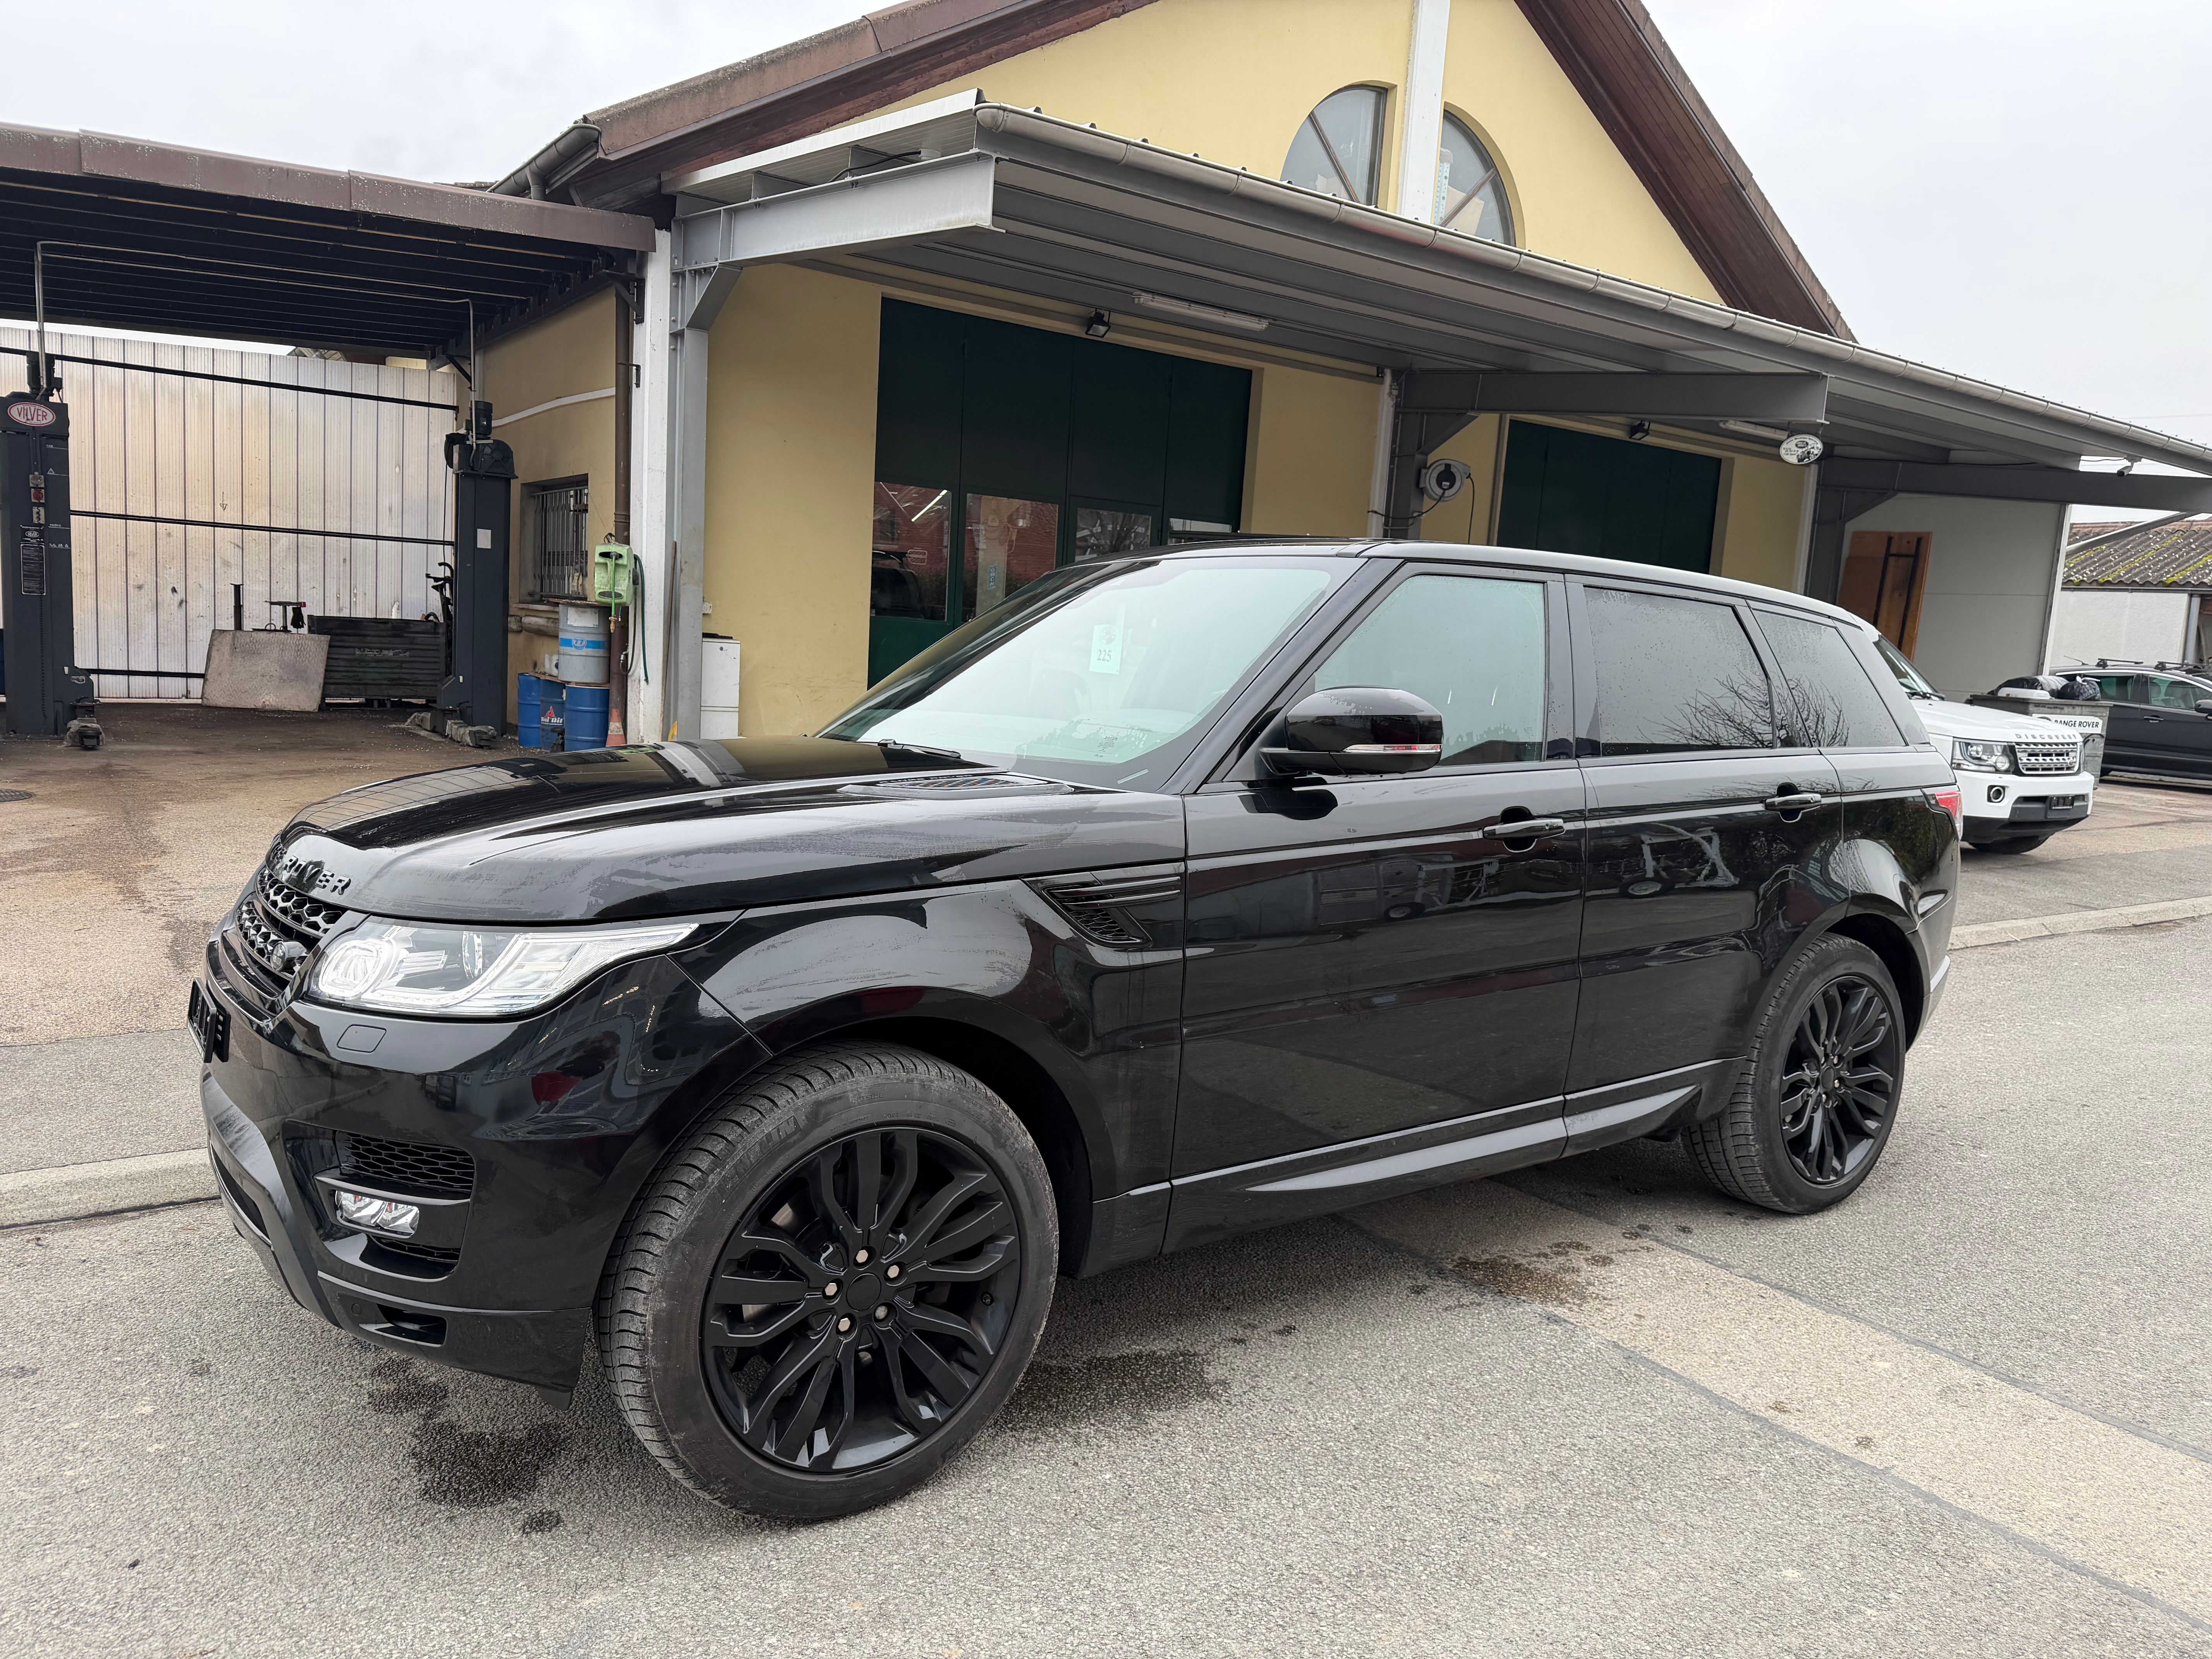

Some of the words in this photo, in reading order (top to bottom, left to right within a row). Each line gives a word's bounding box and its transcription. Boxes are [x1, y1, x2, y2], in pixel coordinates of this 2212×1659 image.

[17, 407, 47, 421] VILVER
[1097, 649, 1112, 662] 225
[283, 855, 351, 895] ROVER
